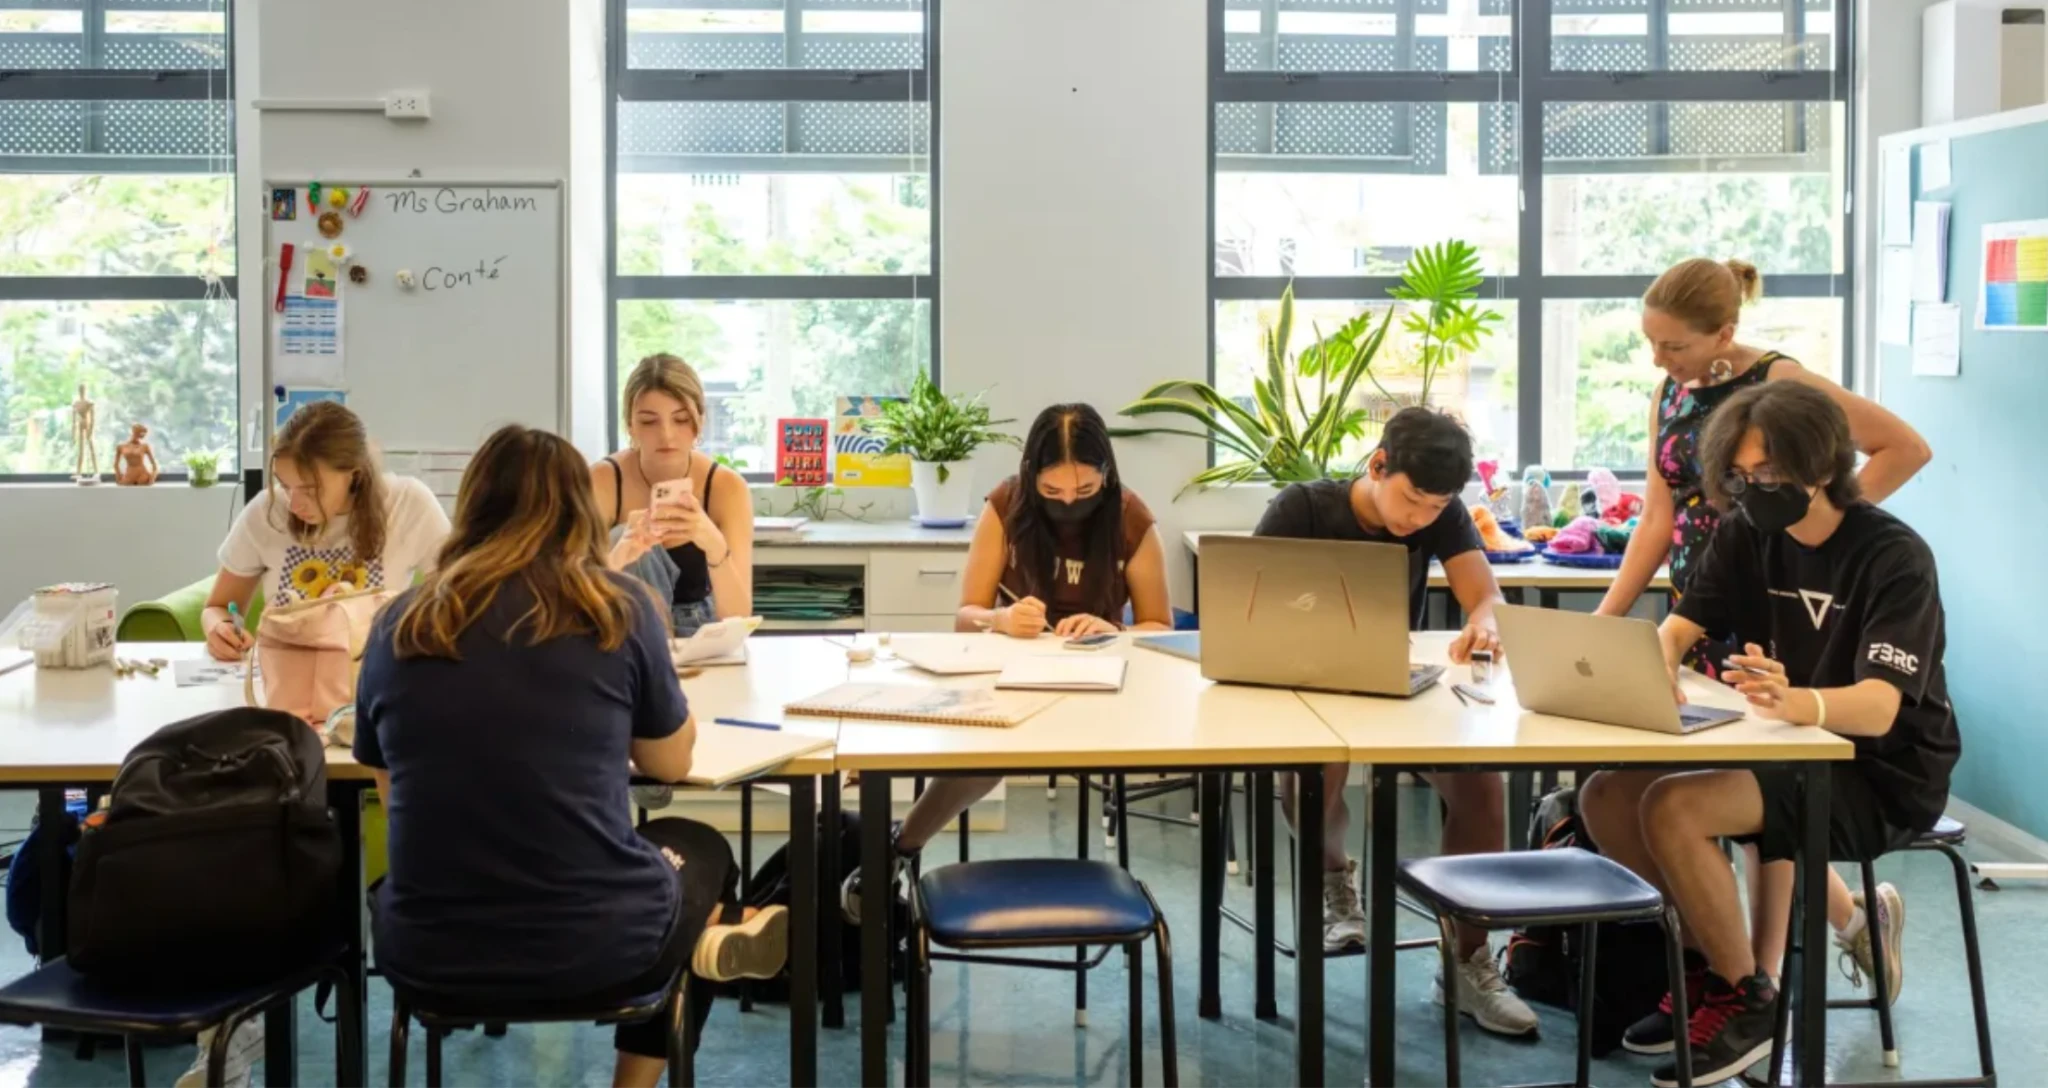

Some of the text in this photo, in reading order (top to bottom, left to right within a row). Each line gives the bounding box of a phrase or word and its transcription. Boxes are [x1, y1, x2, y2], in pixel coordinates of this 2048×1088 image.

[385, 187, 537, 213] Ms Graham
[422, 255, 508, 291] Conté
